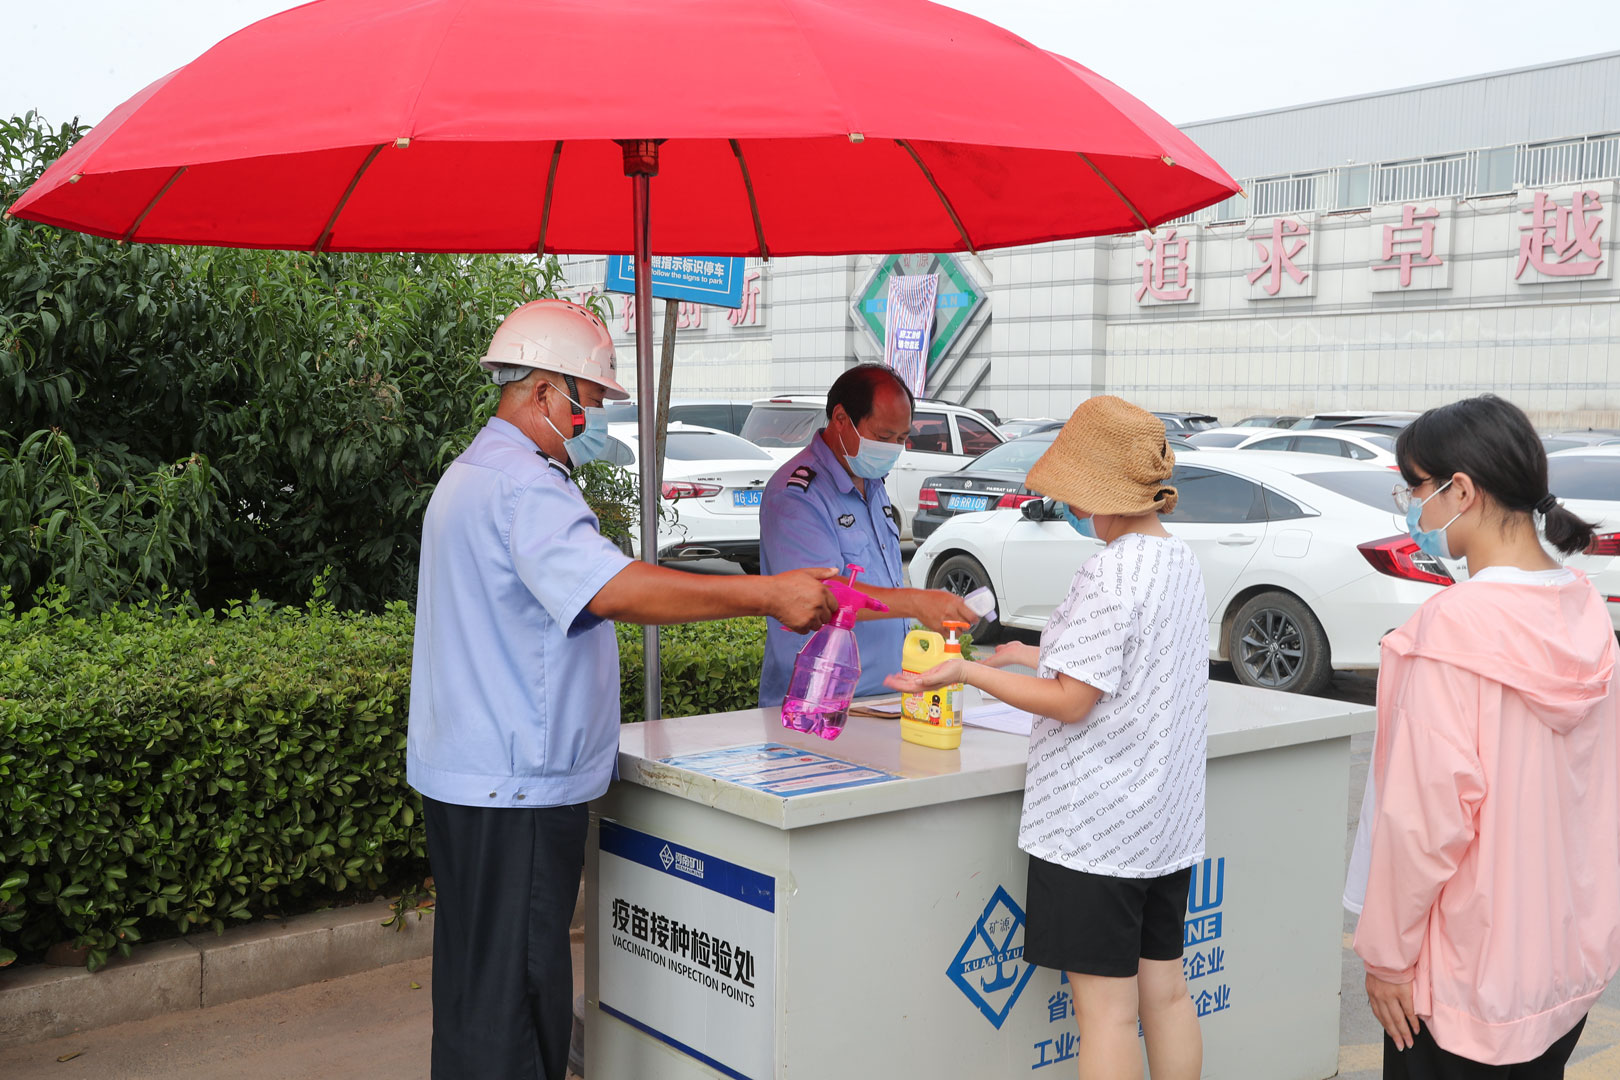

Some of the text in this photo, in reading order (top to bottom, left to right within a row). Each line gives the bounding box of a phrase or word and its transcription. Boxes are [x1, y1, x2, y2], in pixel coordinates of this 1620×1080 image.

[1134, 189, 1604, 302] 追求卓越
[683, 274, 700, 282] signs
[708, 277, 723, 285] park
[1090, 603, 1122, 619] Charles
[1078, 628, 1111, 645] Charles
[1066, 653, 1102, 669] Charles
[1036, 769, 1058, 786] Charles
[1107, 717, 1138, 740] Charles
[1041, 744, 1067, 761] Charles
[1029, 793, 1051, 810] Charles
[1104, 742, 1136, 764] Charles
[1021, 818, 1044, 833] Charles
[1046, 802, 1071, 819] Charles
[1069, 791, 1099, 812] Charles
[1100, 768, 1132, 790] Charles
[1039, 827, 1064, 843] Charles
[1065, 816, 1095, 837] Charles
[1096, 793, 1128, 816] Charles
[1128, 767, 1159, 793] Charles
[1061, 842, 1091, 861] Charles
[1093, 819, 1125, 841] Charles
[1126, 794, 1157, 819] Charles
[1089, 845, 1120, 867] Charles
[1122, 820, 1153, 845] Charles
[1154, 792, 1172, 819] Charles
[1118, 846, 1149, 870] Charles
[1150, 817, 1170, 845] Charles
[1145, 844, 1168, 870] Charles
[612, 898, 755, 988] 疫苗接种检验处
[989, 917, 1010, 935] 矿源
[612, 933, 755, 1008] VACCINATION INSPECTION POINTS
[964, 946, 1024, 973] KUANGYU
[1047, 991, 1075, 1023] 省
[1190, 984, 1231, 1017] 企业
[1031, 1031, 1081, 1070] 工业
